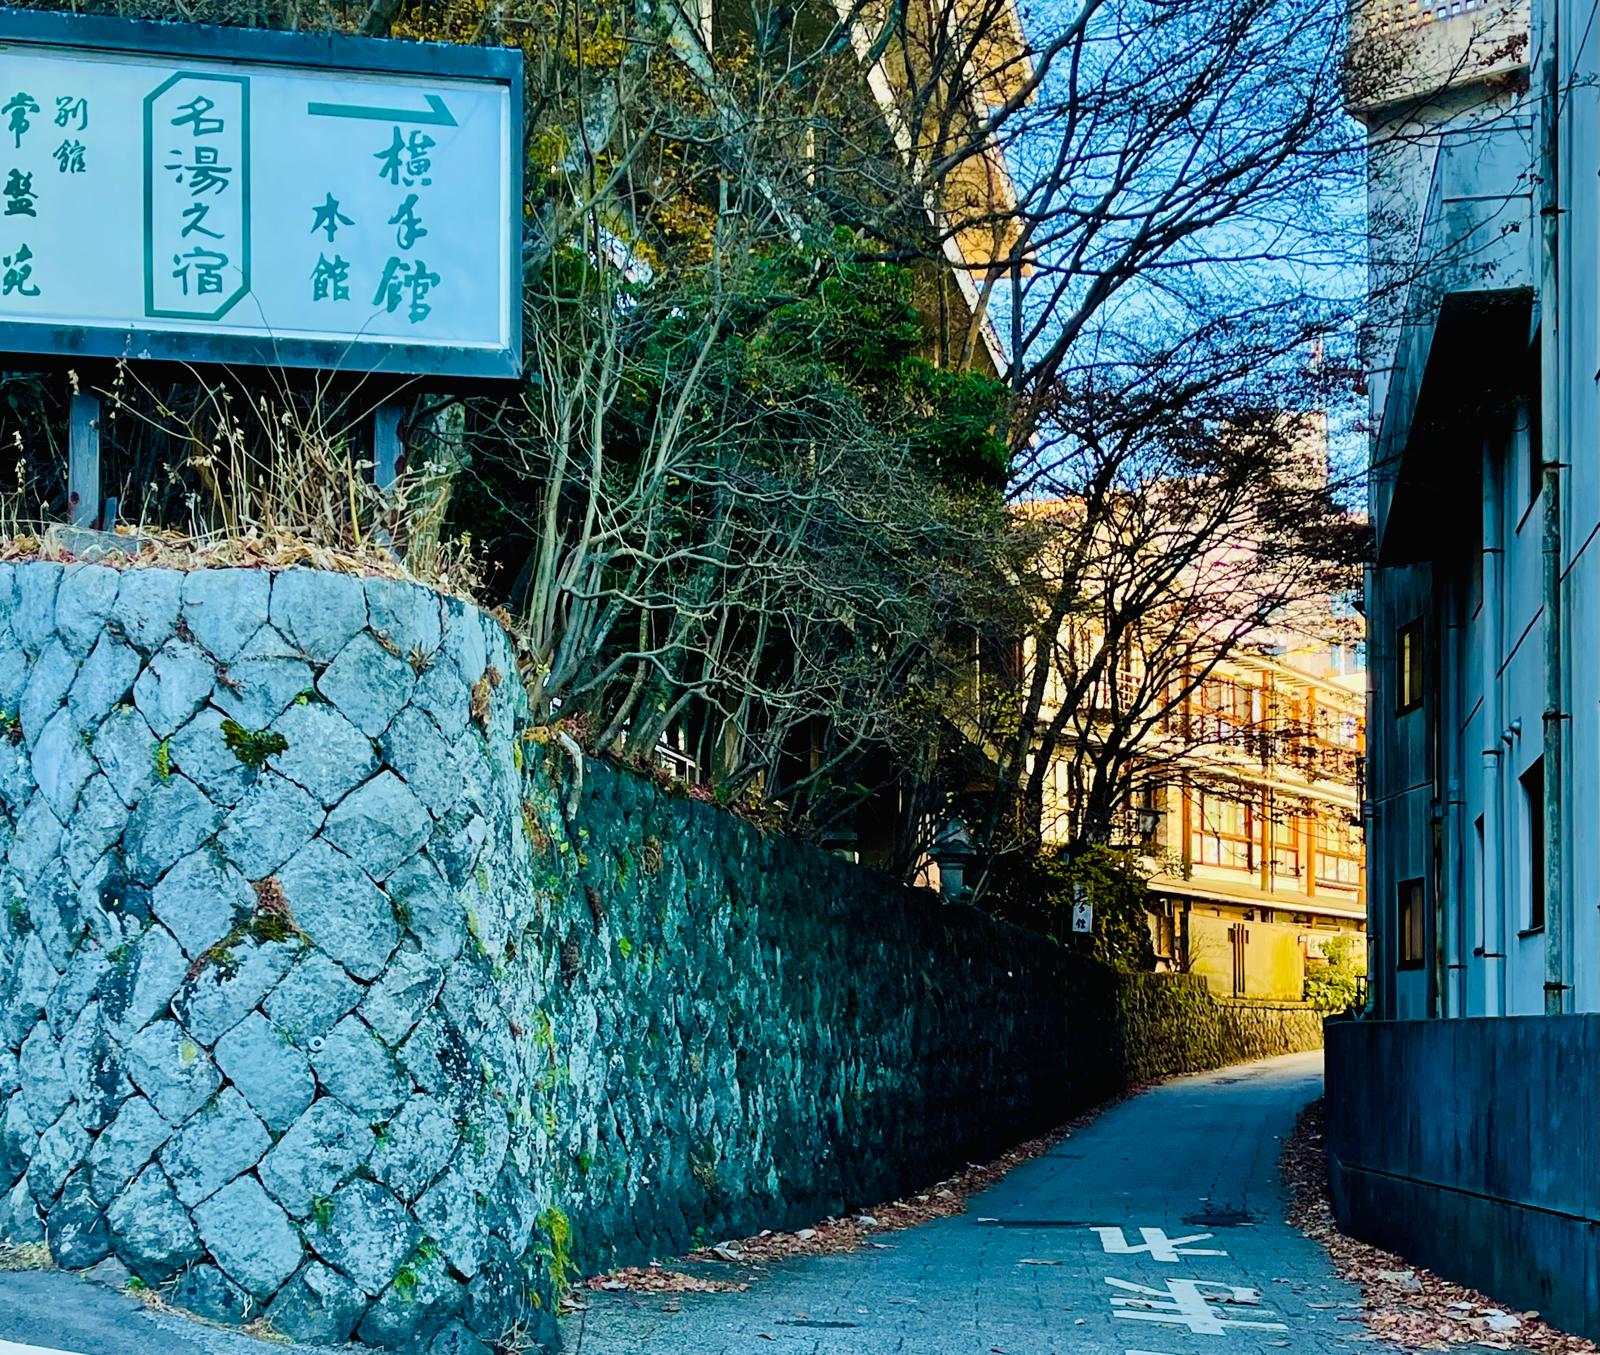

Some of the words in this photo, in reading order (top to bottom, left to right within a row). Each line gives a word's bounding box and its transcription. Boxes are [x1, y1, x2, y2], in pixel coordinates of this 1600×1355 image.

[1, 91, 41, 297] 常盤苑
[164, 95, 232, 296] 名湯之宿
[310, 192, 355, 301] 本館
[372, 126, 441, 324] 横手館
[1089, 1227, 1289, 1355] まれ
